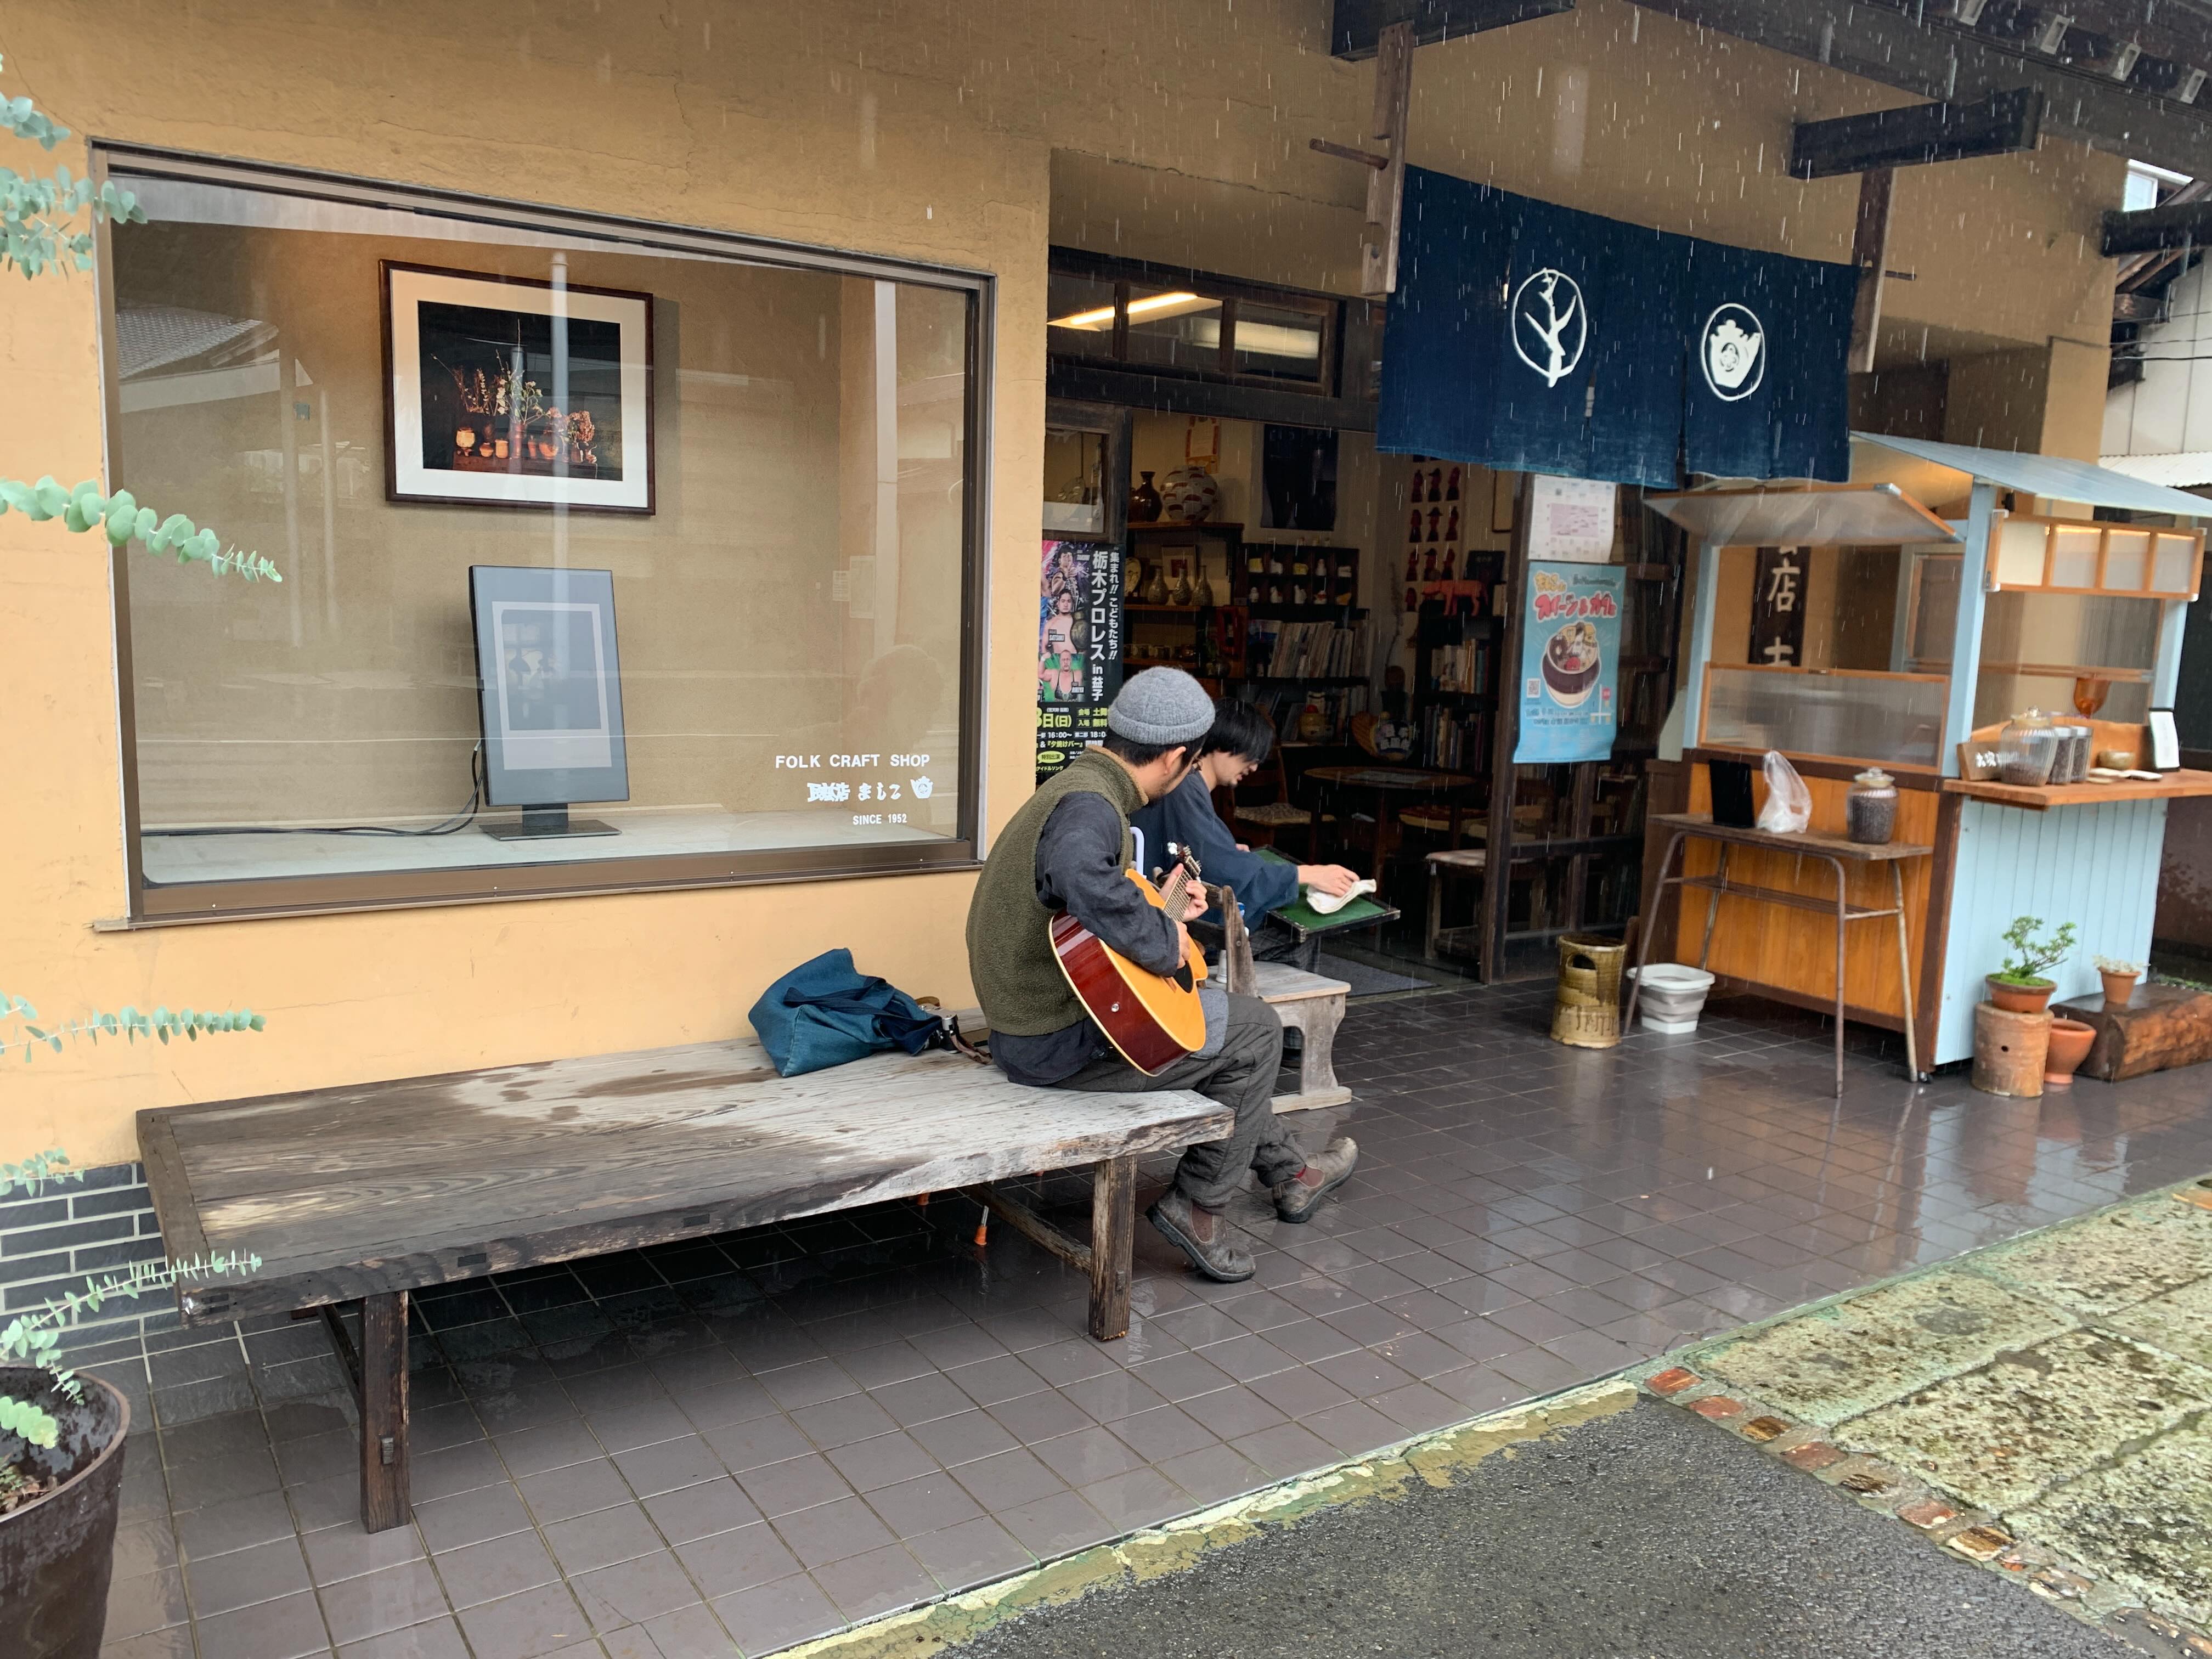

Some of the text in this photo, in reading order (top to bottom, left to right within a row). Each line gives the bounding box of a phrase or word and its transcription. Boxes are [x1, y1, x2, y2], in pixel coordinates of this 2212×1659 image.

[775, 754, 930, 769] FOLK CRAFT SHOP
[853, 814, 907, 825] SINCE 1952
